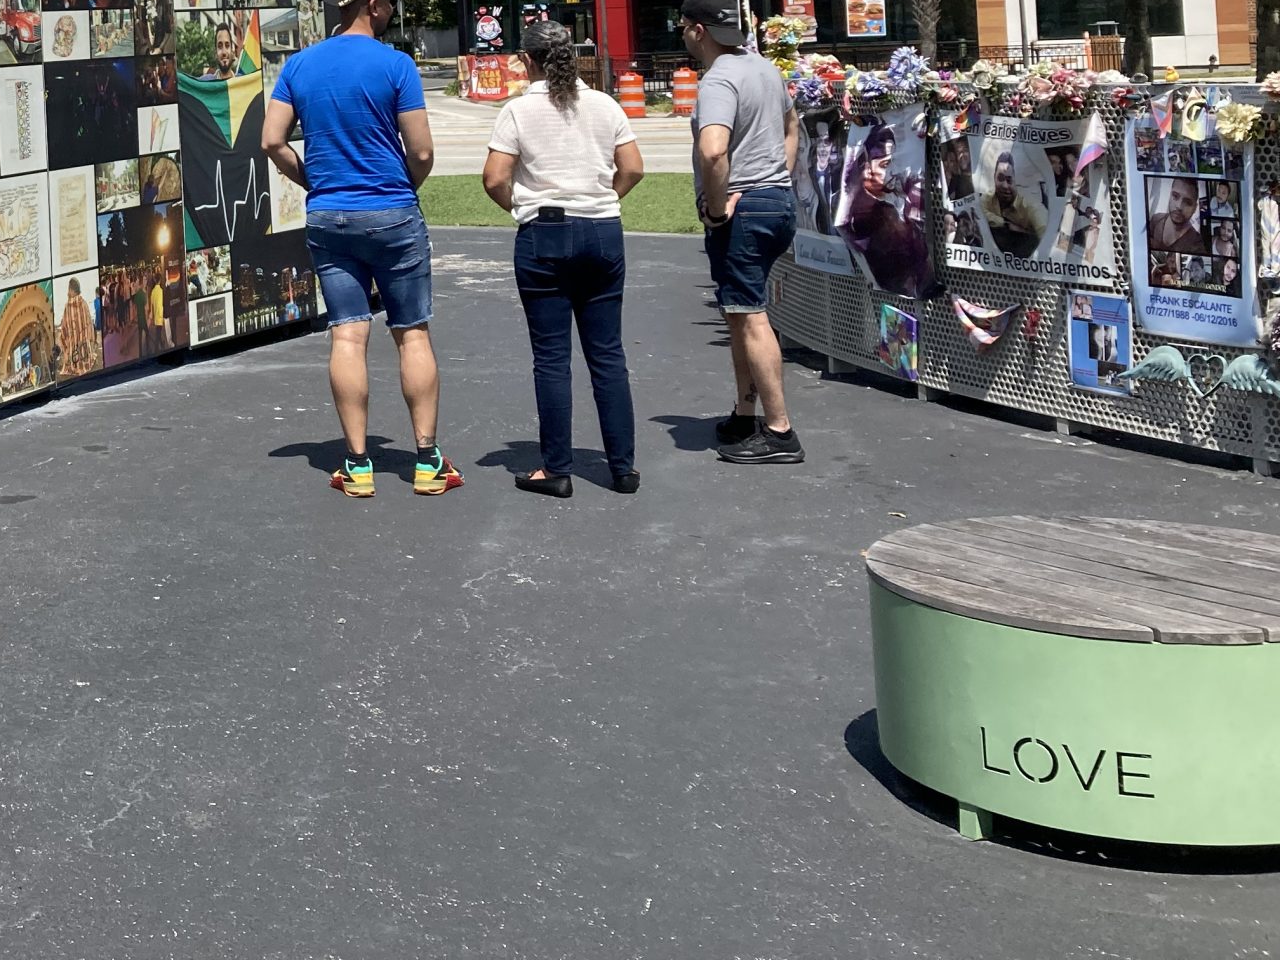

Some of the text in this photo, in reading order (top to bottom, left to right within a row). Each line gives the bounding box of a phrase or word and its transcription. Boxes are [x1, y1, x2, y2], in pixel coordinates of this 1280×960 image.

[982, 118, 1018, 140] Carlos
[1019, 121, 1072, 144] Nieves
[946, 247, 1111, 280] empre te Recordaremos
[1145, 305, 1190, 320] 07/27/1988
[1149, 294, 1232, 314] FRANK ESCALANTE
[980, 726, 1156, 799] LOVE
